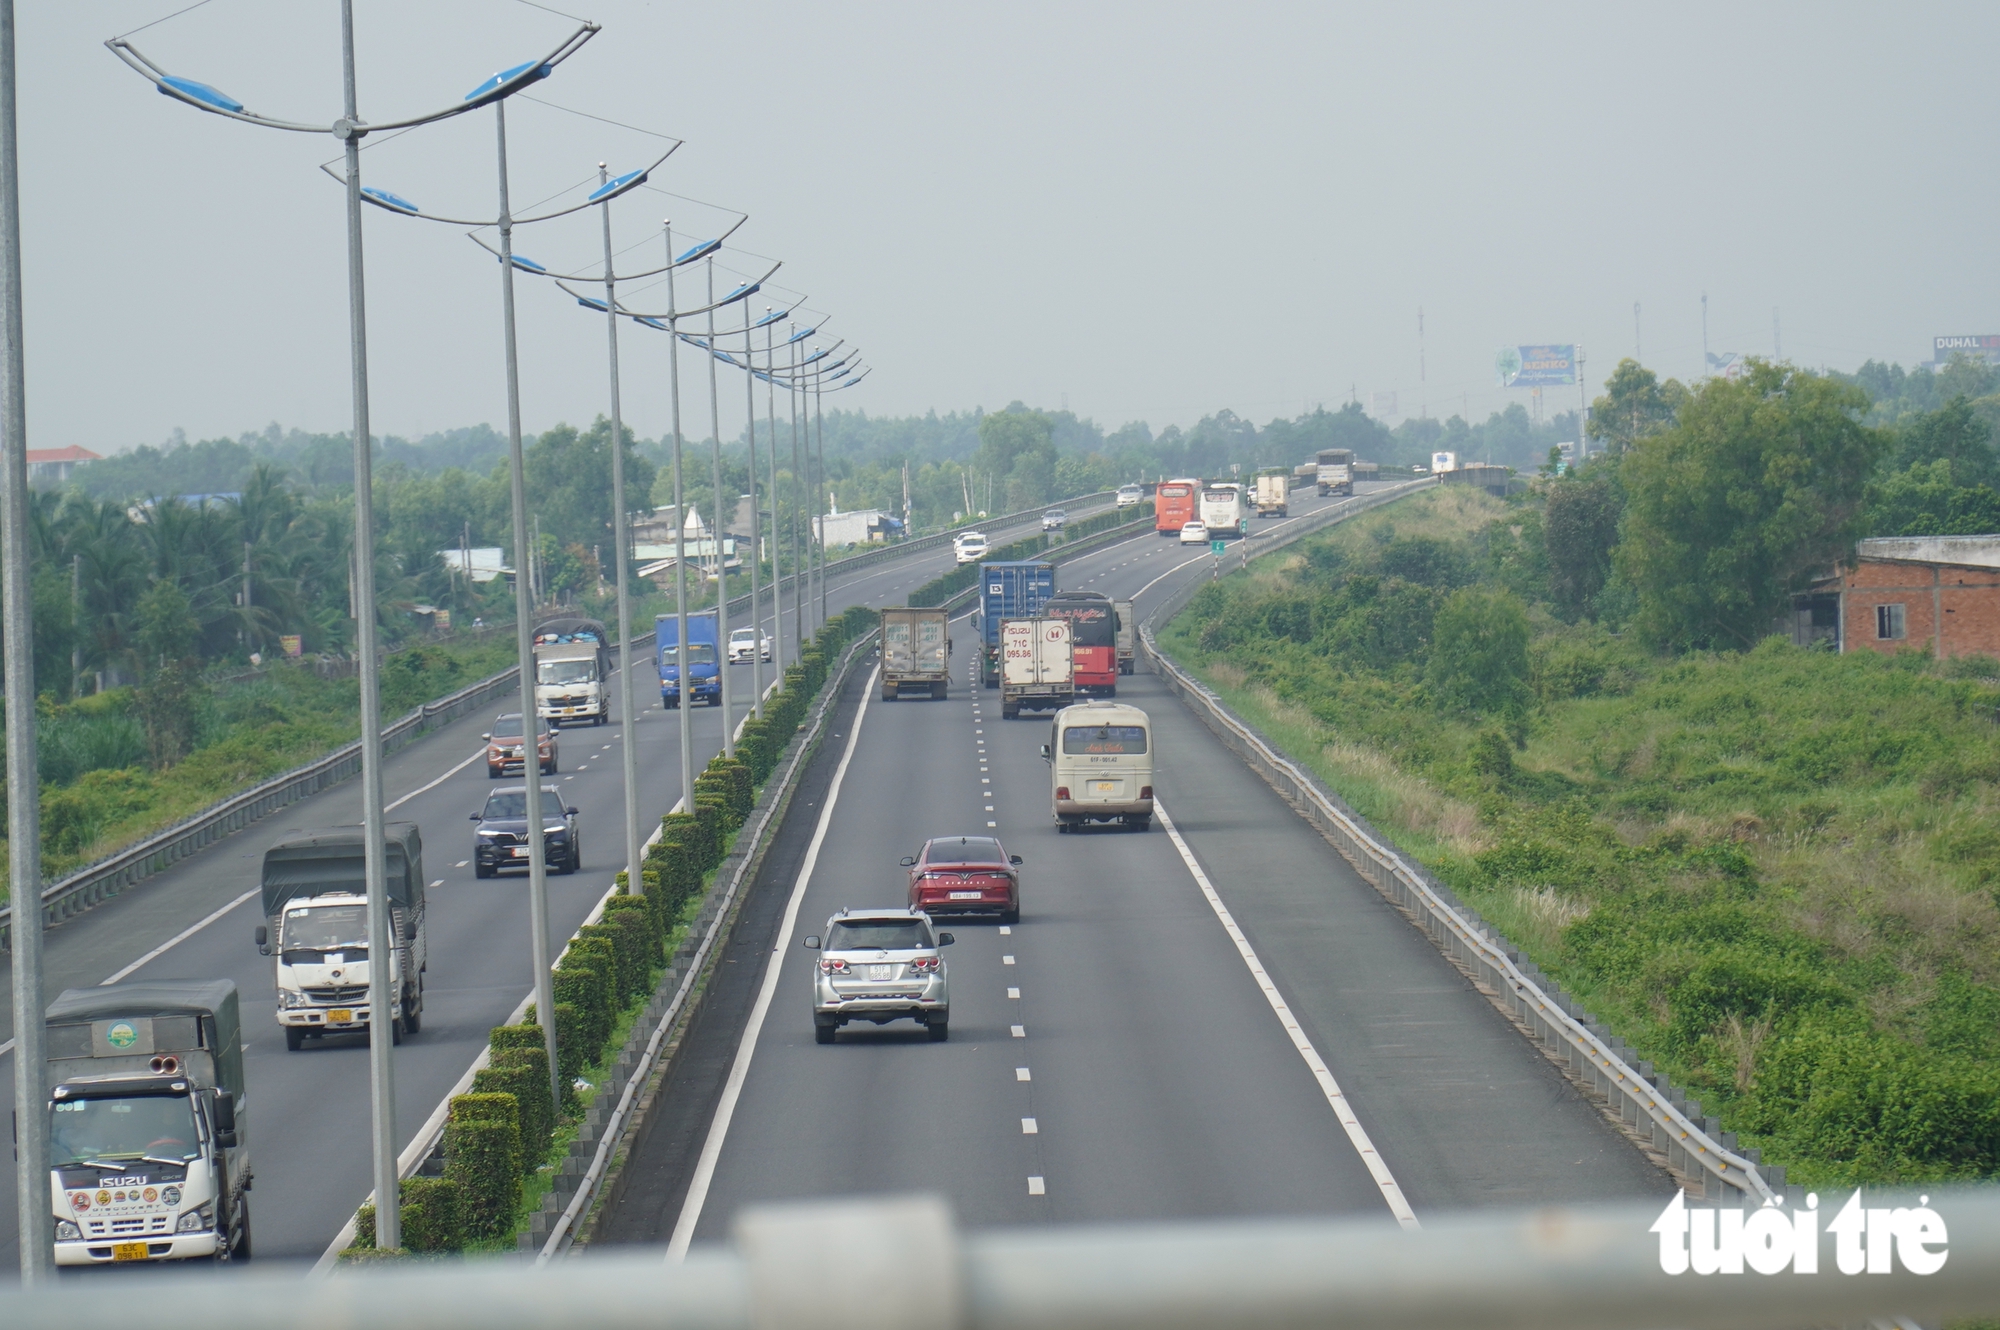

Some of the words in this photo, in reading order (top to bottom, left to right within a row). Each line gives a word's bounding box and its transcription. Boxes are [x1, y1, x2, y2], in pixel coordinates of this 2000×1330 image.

[1936, 337, 1980, 349] DUHAL
[1981, 336, 2000, 348] LE
[1523, 359, 1569, 370] SENKO
[1008, 627, 1031, 635] ISUZU
[1013, 639, 1028, 648] 71C
[1006, 649, 1032, 658] 095.86
[99, 1175, 148, 1188] ISUZU
[122, 1243, 138, 1252] 63C
